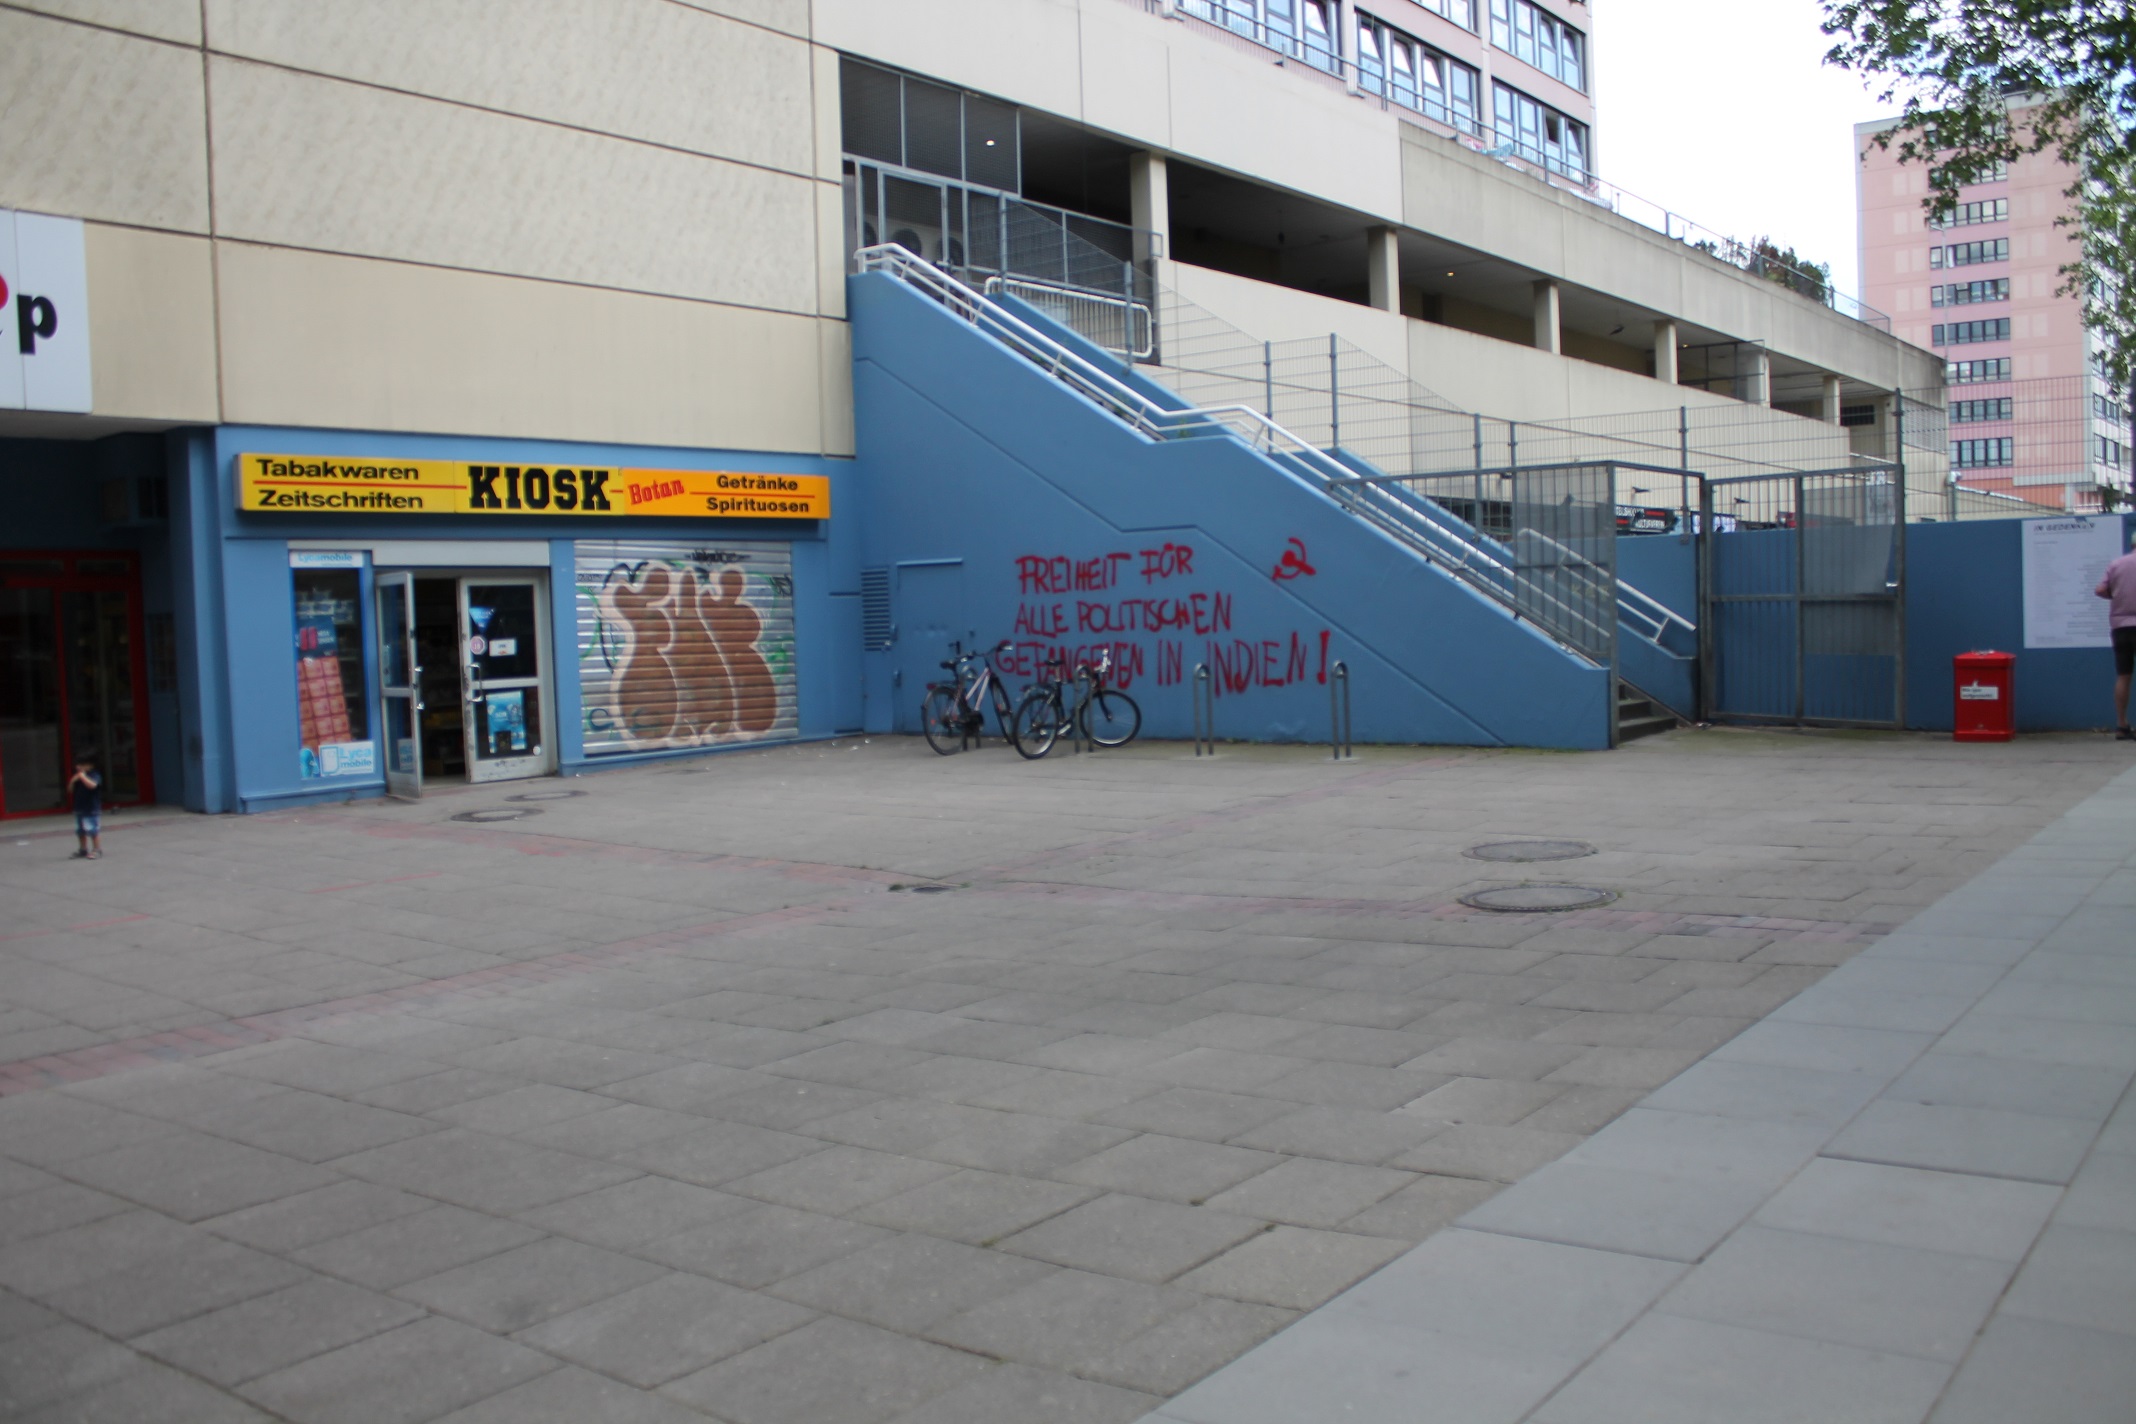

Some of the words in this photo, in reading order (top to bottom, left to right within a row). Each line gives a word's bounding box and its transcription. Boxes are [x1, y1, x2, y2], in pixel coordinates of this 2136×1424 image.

[16, 293, 58, 355] p
[256, 459, 419, 480] Tabakwaren
[468, 466, 611, 511] KIOSK
[716, 475, 798, 491] Getränke
[258, 490, 423, 509] Zeitschriften
[706, 497, 809, 514] Spirituosen
[1015, 554, 1131, 594] FREIHEIT
[1014, 602, 1070, 638] ALLE
[1076, 591, 1232, 634] POLITISCHEN
[1157, 639, 1183, 686] IN
